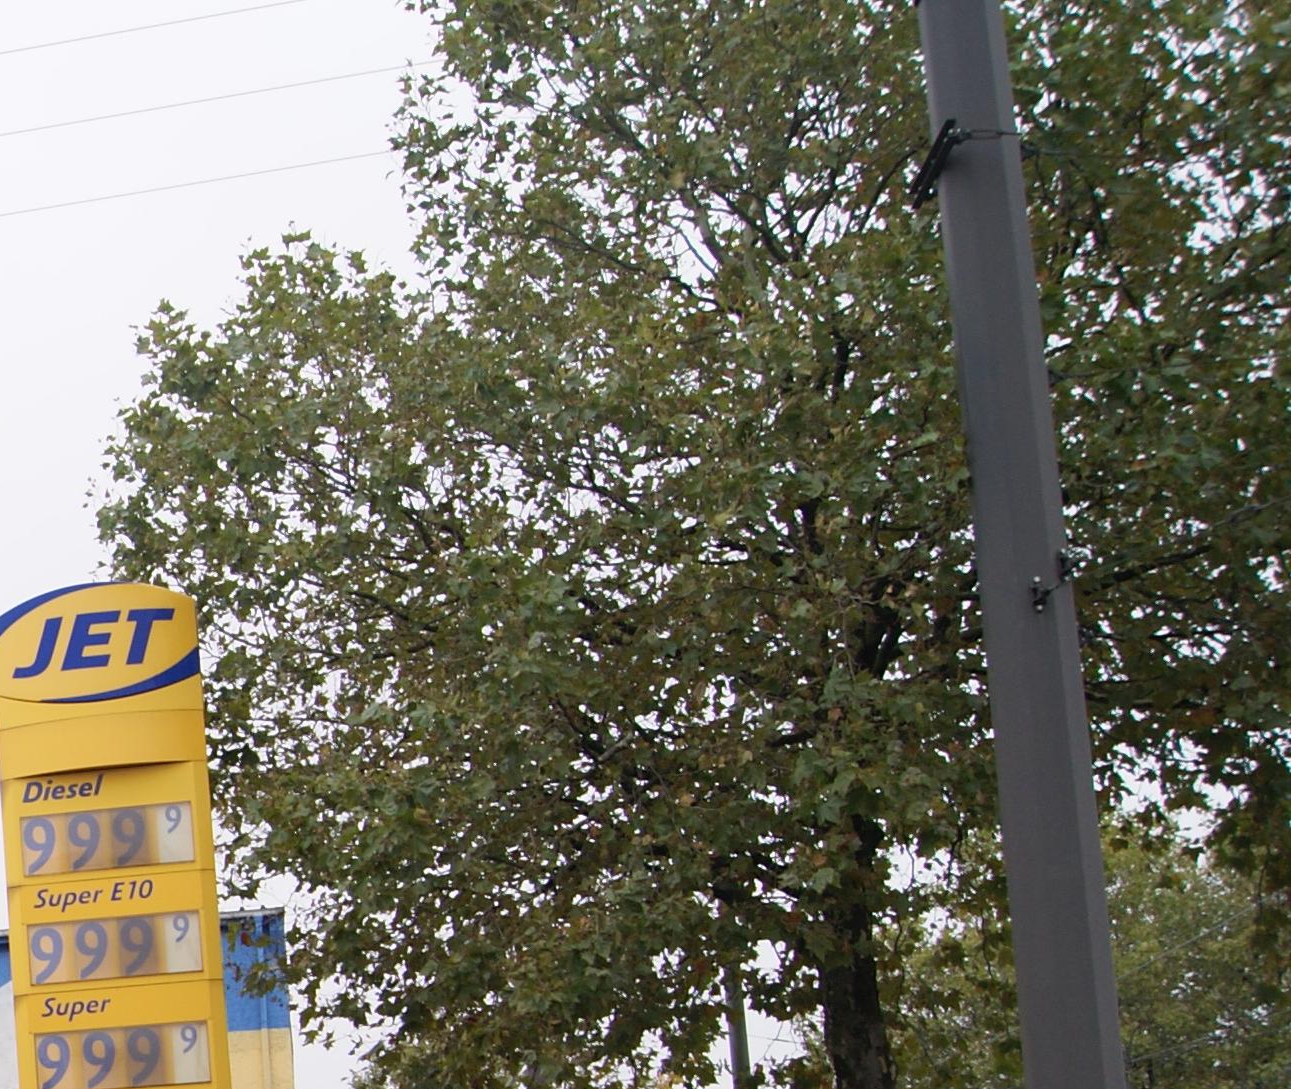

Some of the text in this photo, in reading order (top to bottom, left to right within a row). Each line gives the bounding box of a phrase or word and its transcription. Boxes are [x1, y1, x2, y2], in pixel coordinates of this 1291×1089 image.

[12, 608, 175, 679] JET
[22, 774, 105, 804] Diesel
[33, 879, 154, 912] Super E10
[41, 997, 111, 1022] Super
